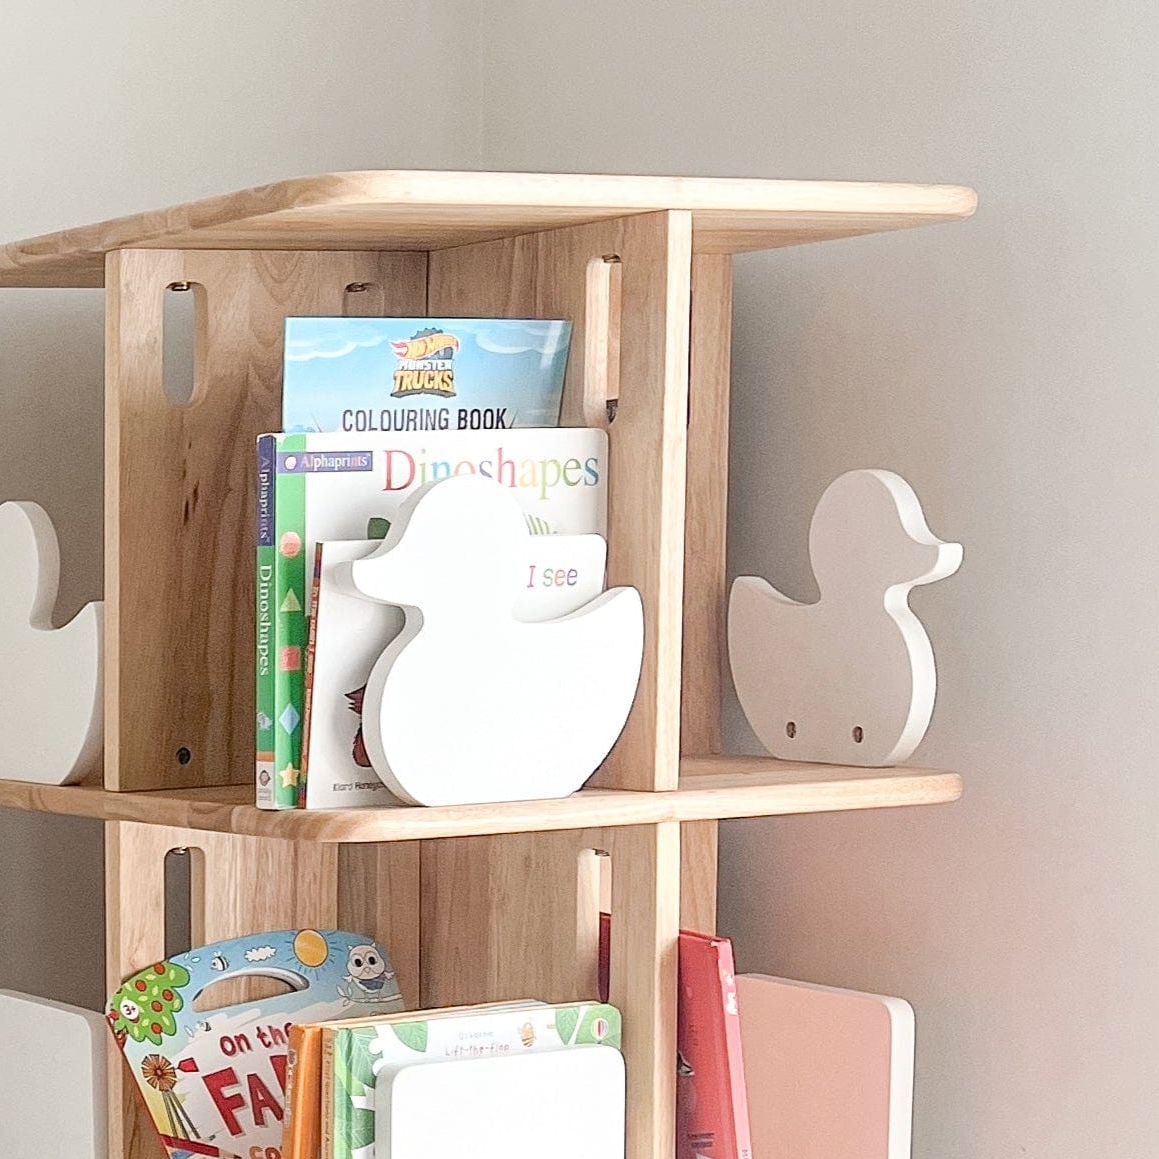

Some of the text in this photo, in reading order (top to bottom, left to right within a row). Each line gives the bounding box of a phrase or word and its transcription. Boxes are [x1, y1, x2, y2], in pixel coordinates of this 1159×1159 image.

[394, 370, 454, 393] TRUCKS
[342, 408, 507, 432] COLOURING BOOK
[300, 453, 369, 472] Alphaprints
[259, 455, 272, 540] Alphaprints
[526, 565, 579, 588] I see
[259, 564, 273, 676] Dinoshapes
[122, 1003, 138, 1016] 3+
[219, 1032, 252, 1057] on
